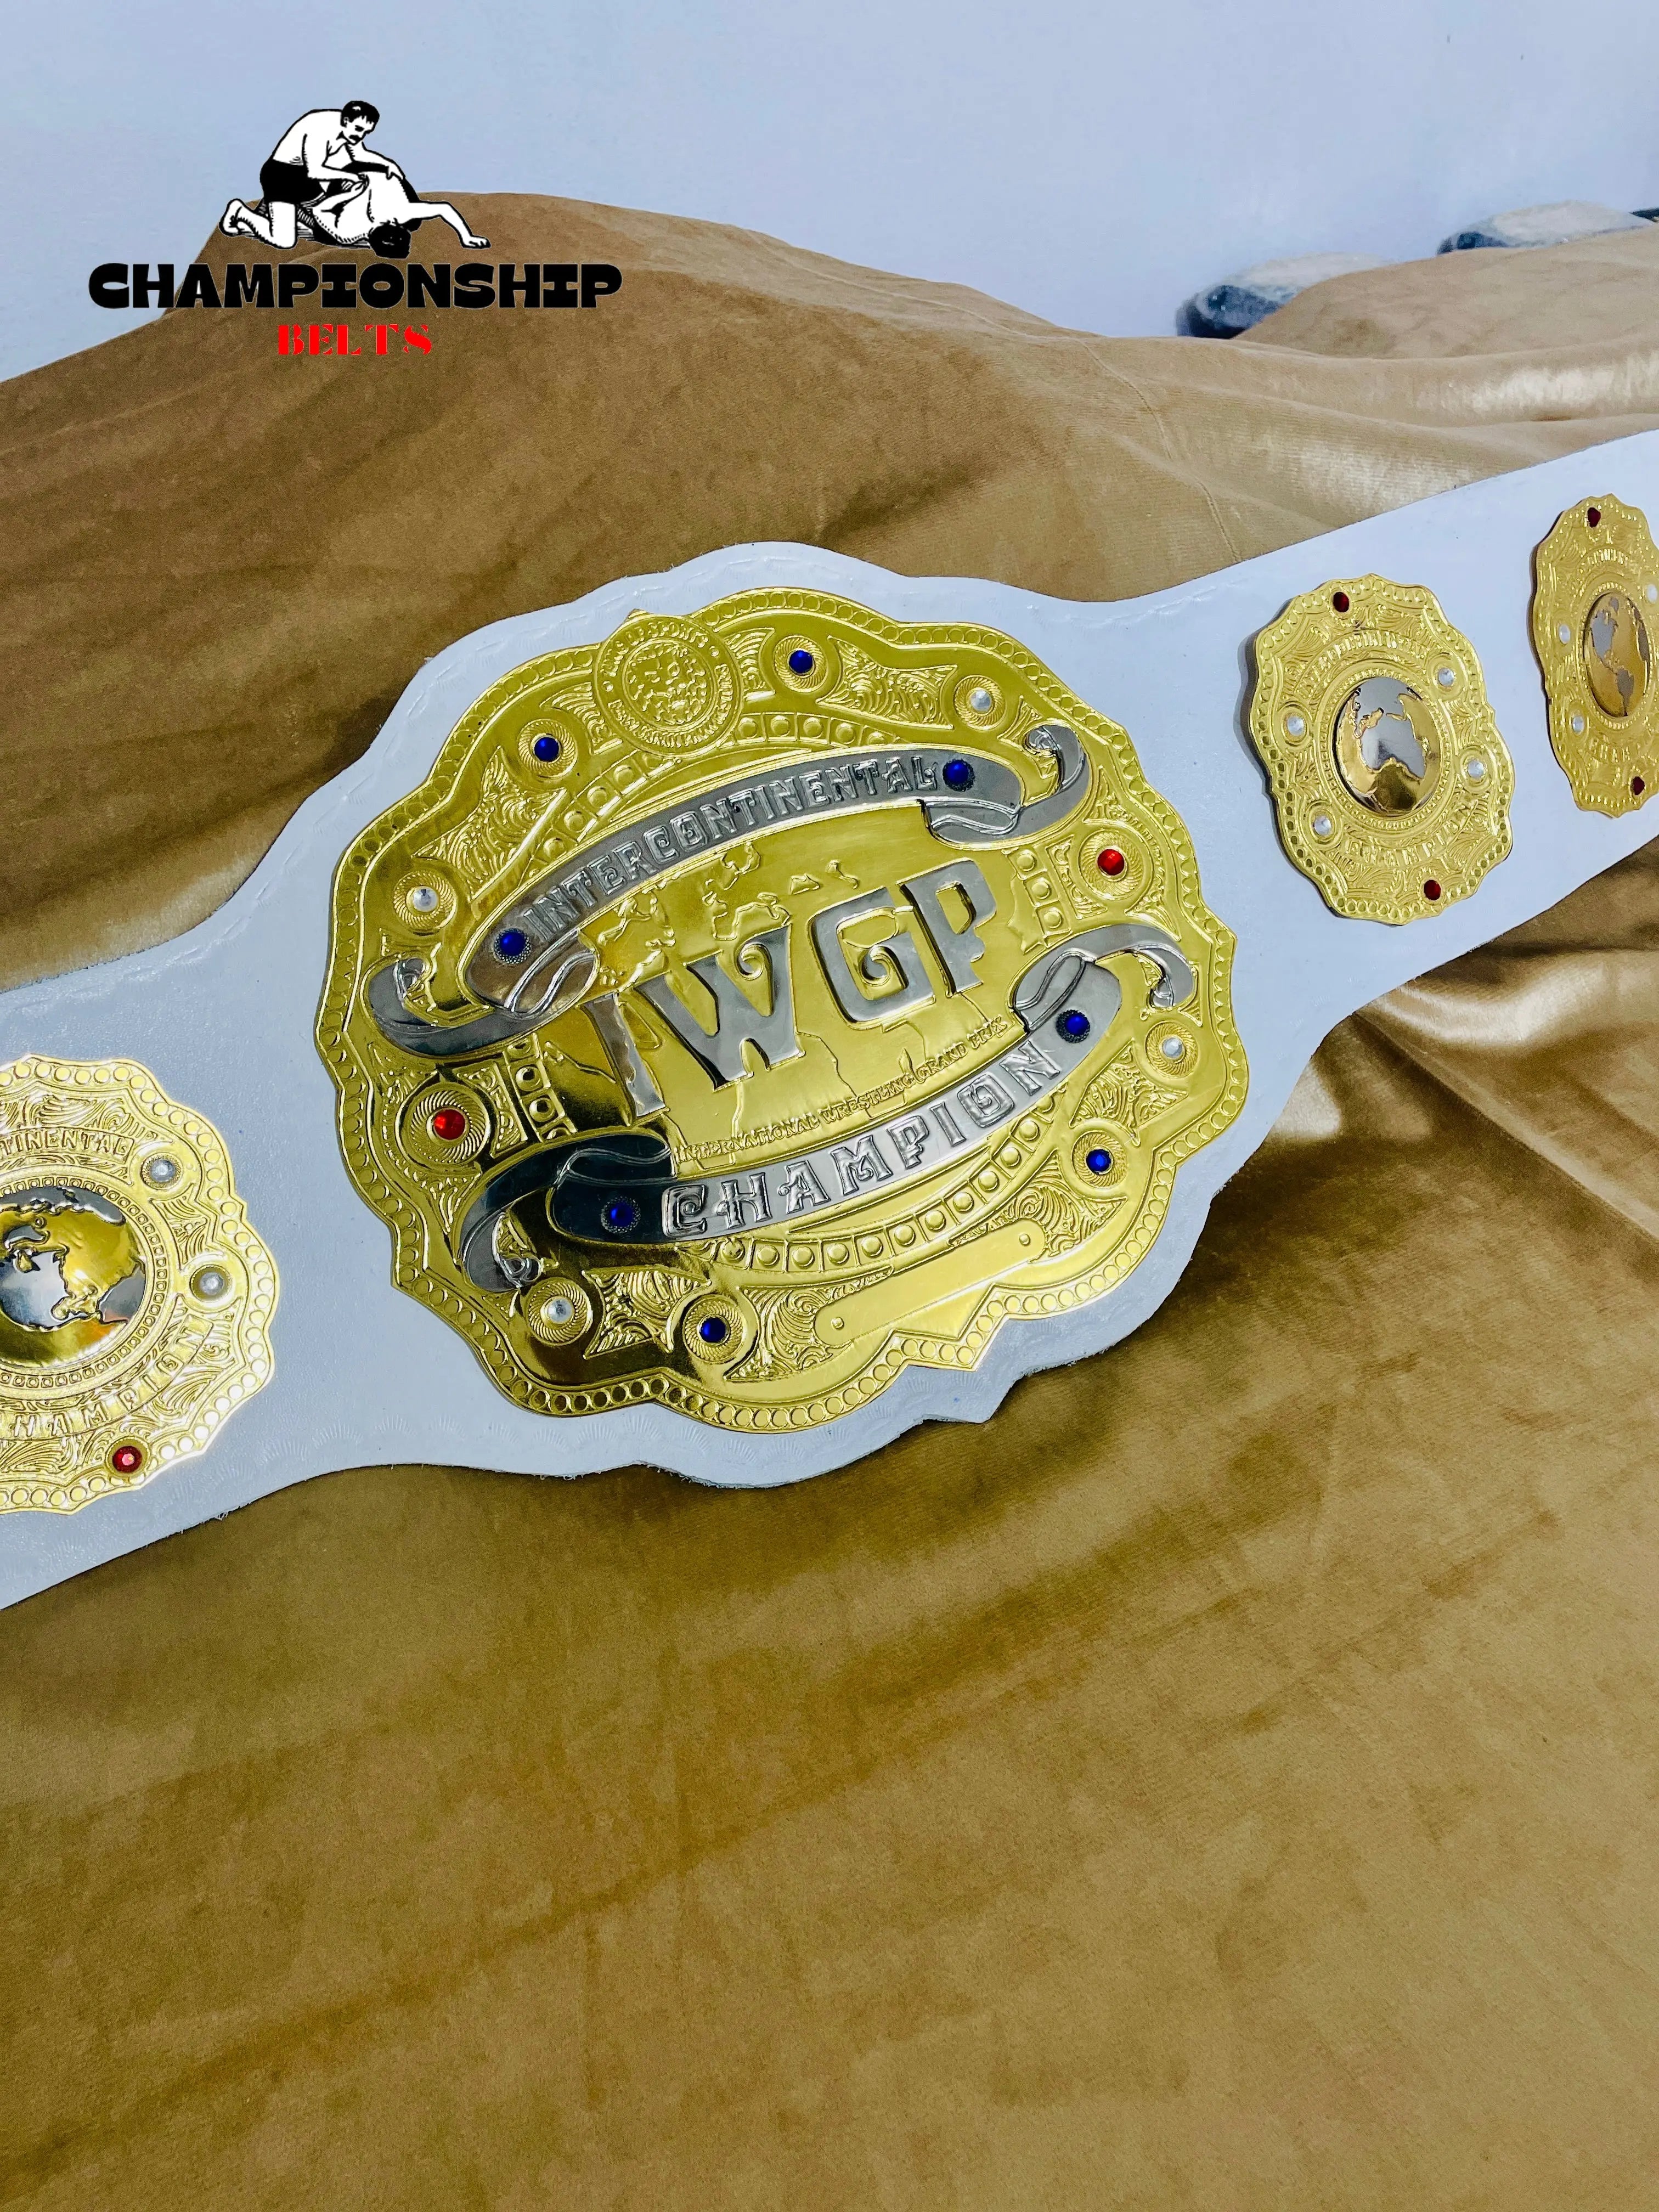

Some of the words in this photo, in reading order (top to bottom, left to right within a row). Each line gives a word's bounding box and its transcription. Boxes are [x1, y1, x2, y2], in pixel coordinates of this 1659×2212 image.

[523, 755, 939, 940] INTERCONTINENTAL
[578, 857, 997, 1119] IWGP
[661, 1041, 1062, 1238] CHAMPION
[674, 1111, 820, 1164] INTERNATIONAL
[817, 1072, 916, 1124] WRESTLING
[916, 1041, 969, 1082] GRAND
